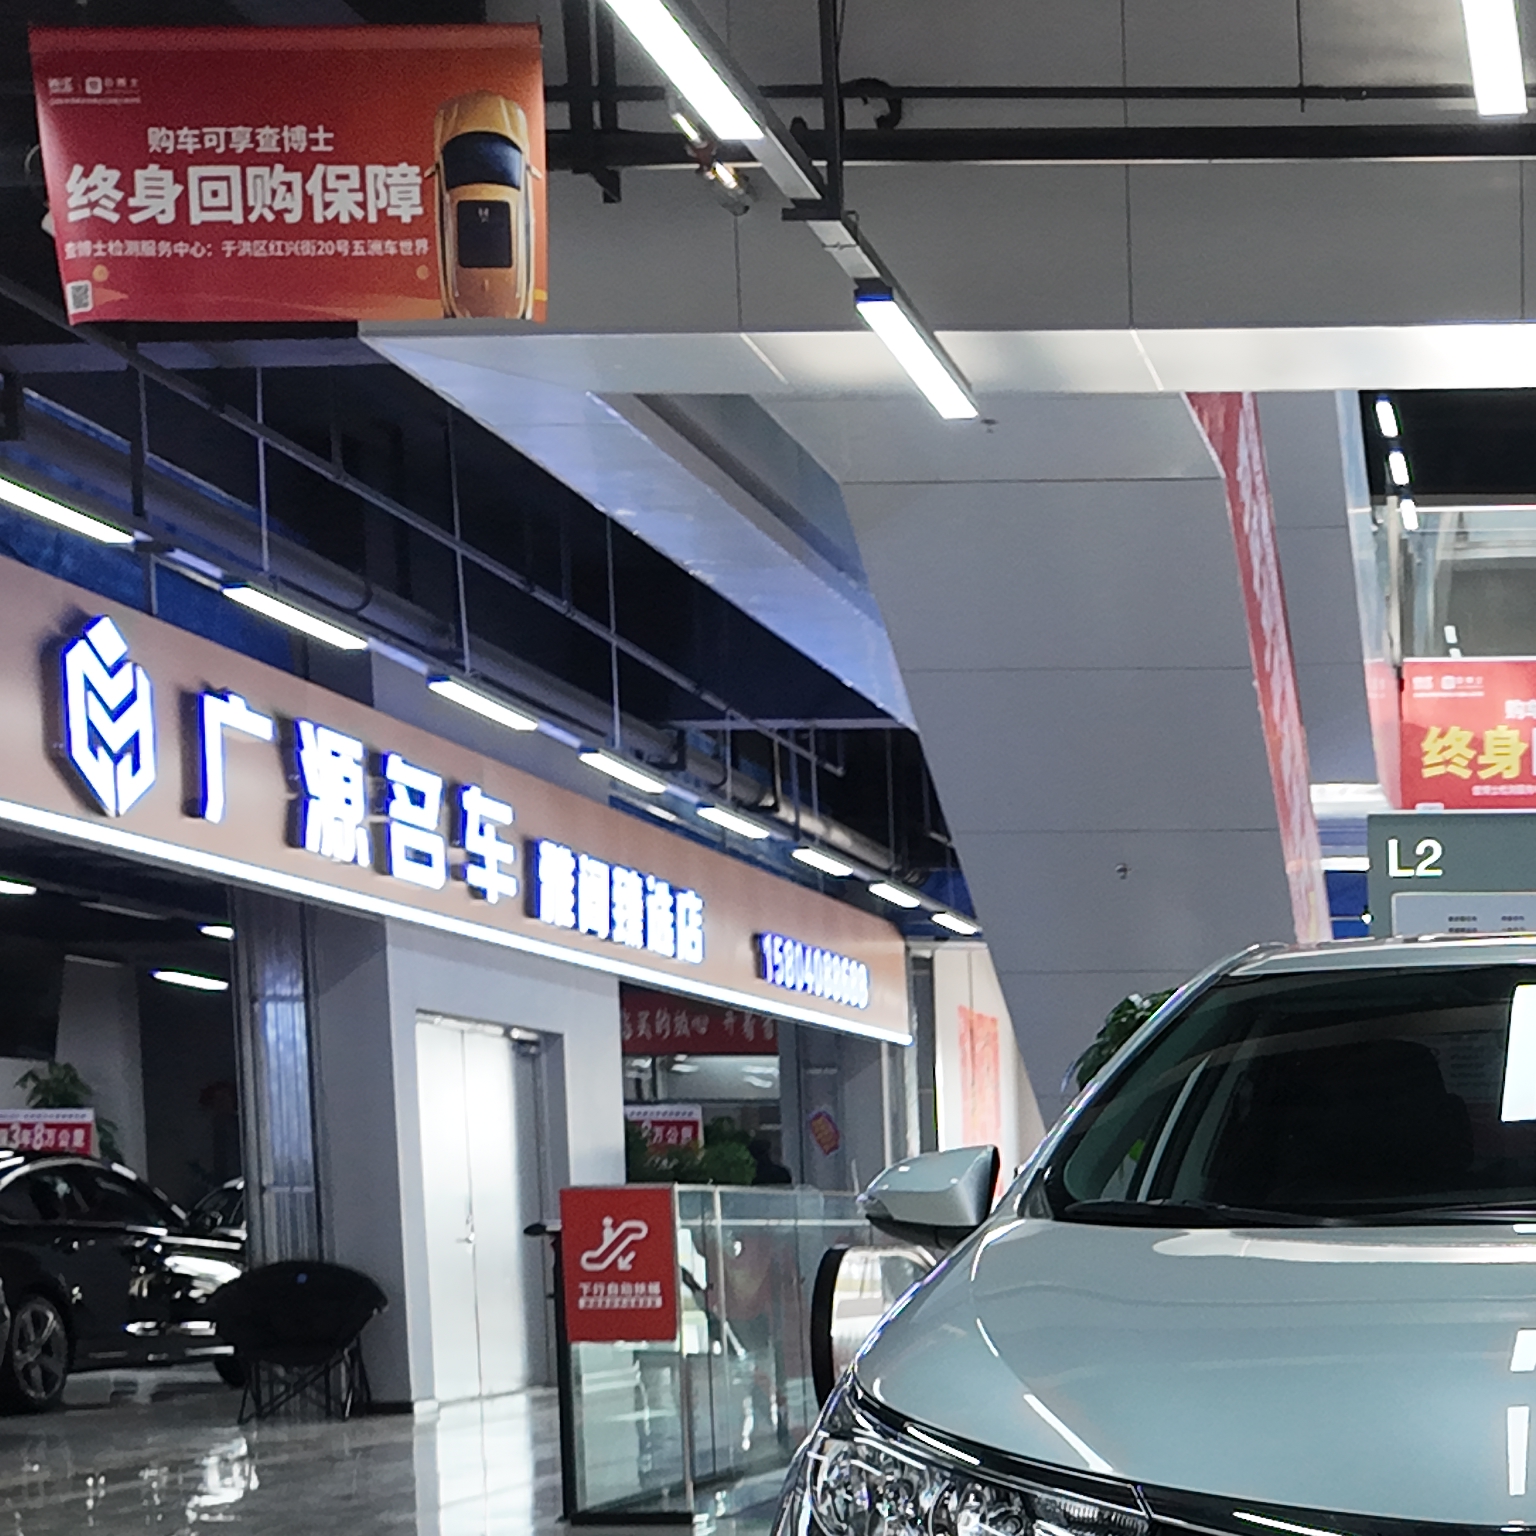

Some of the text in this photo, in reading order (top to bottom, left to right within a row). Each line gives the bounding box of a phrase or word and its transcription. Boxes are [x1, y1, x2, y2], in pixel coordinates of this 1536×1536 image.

[147, 125, 335, 155] 购车可享查博士
[65, 162, 424, 225] 终身回购保障
[198, 690, 520, 904] 广源名车
[1387, 838, 1443, 877] L2
